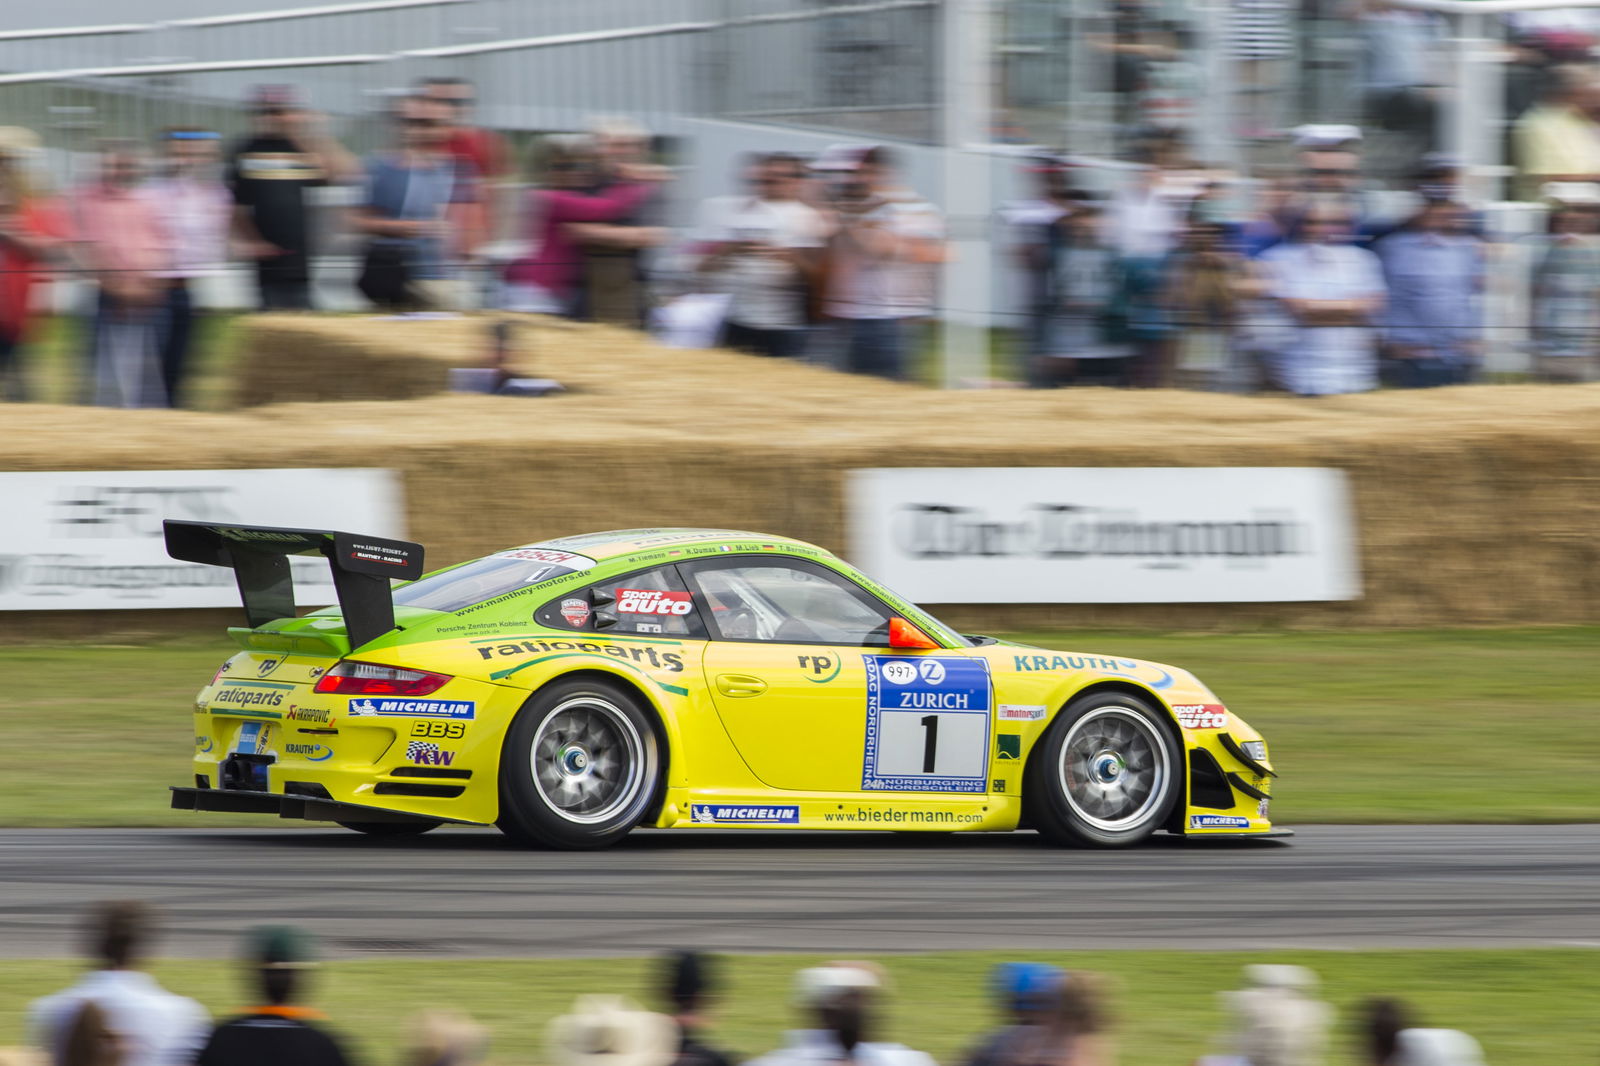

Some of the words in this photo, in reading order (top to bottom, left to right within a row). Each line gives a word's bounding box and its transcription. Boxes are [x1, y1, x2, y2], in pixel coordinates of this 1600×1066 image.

[455, 569, 592, 617] www.manthey-motors.de
[621, 590, 663, 600] sport
[617, 599, 693, 615] auto
[436, 625, 466, 633] Porsche
[468, 622, 498, 630] Zentrum
[477, 639, 684, 673] ratioparts
[1015, 656, 1118, 672] KRAUTH
[259, 659, 277, 673] rp
[798, 655, 831, 674] rp
[864, 655, 878, 692] ADAC
[214, 688, 284, 707] ratioparts
[900, 692, 968, 708] ZURICH
[380, 701, 470, 715] MICHELIN
[1172, 704, 1205, 715] sport
[410, 721, 466, 738] BBS
[864, 696, 877, 779] NORDRHEIN
[285, 743, 314, 754] KRAUTH
[921, 715, 938, 773] 1
[414, 749, 456, 766] KW
[863, 779, 885, 790] 24h
[885, 778, 984, 787] NÜRBURGRING
[885, 784, 983, 792] NORDSCHLEIFE
[716, 808, 795, 819] MICHELIN
[824, 808, 983, 823] www.biedermann.com
[1202, 816, 1248, 825] MICHELIN
